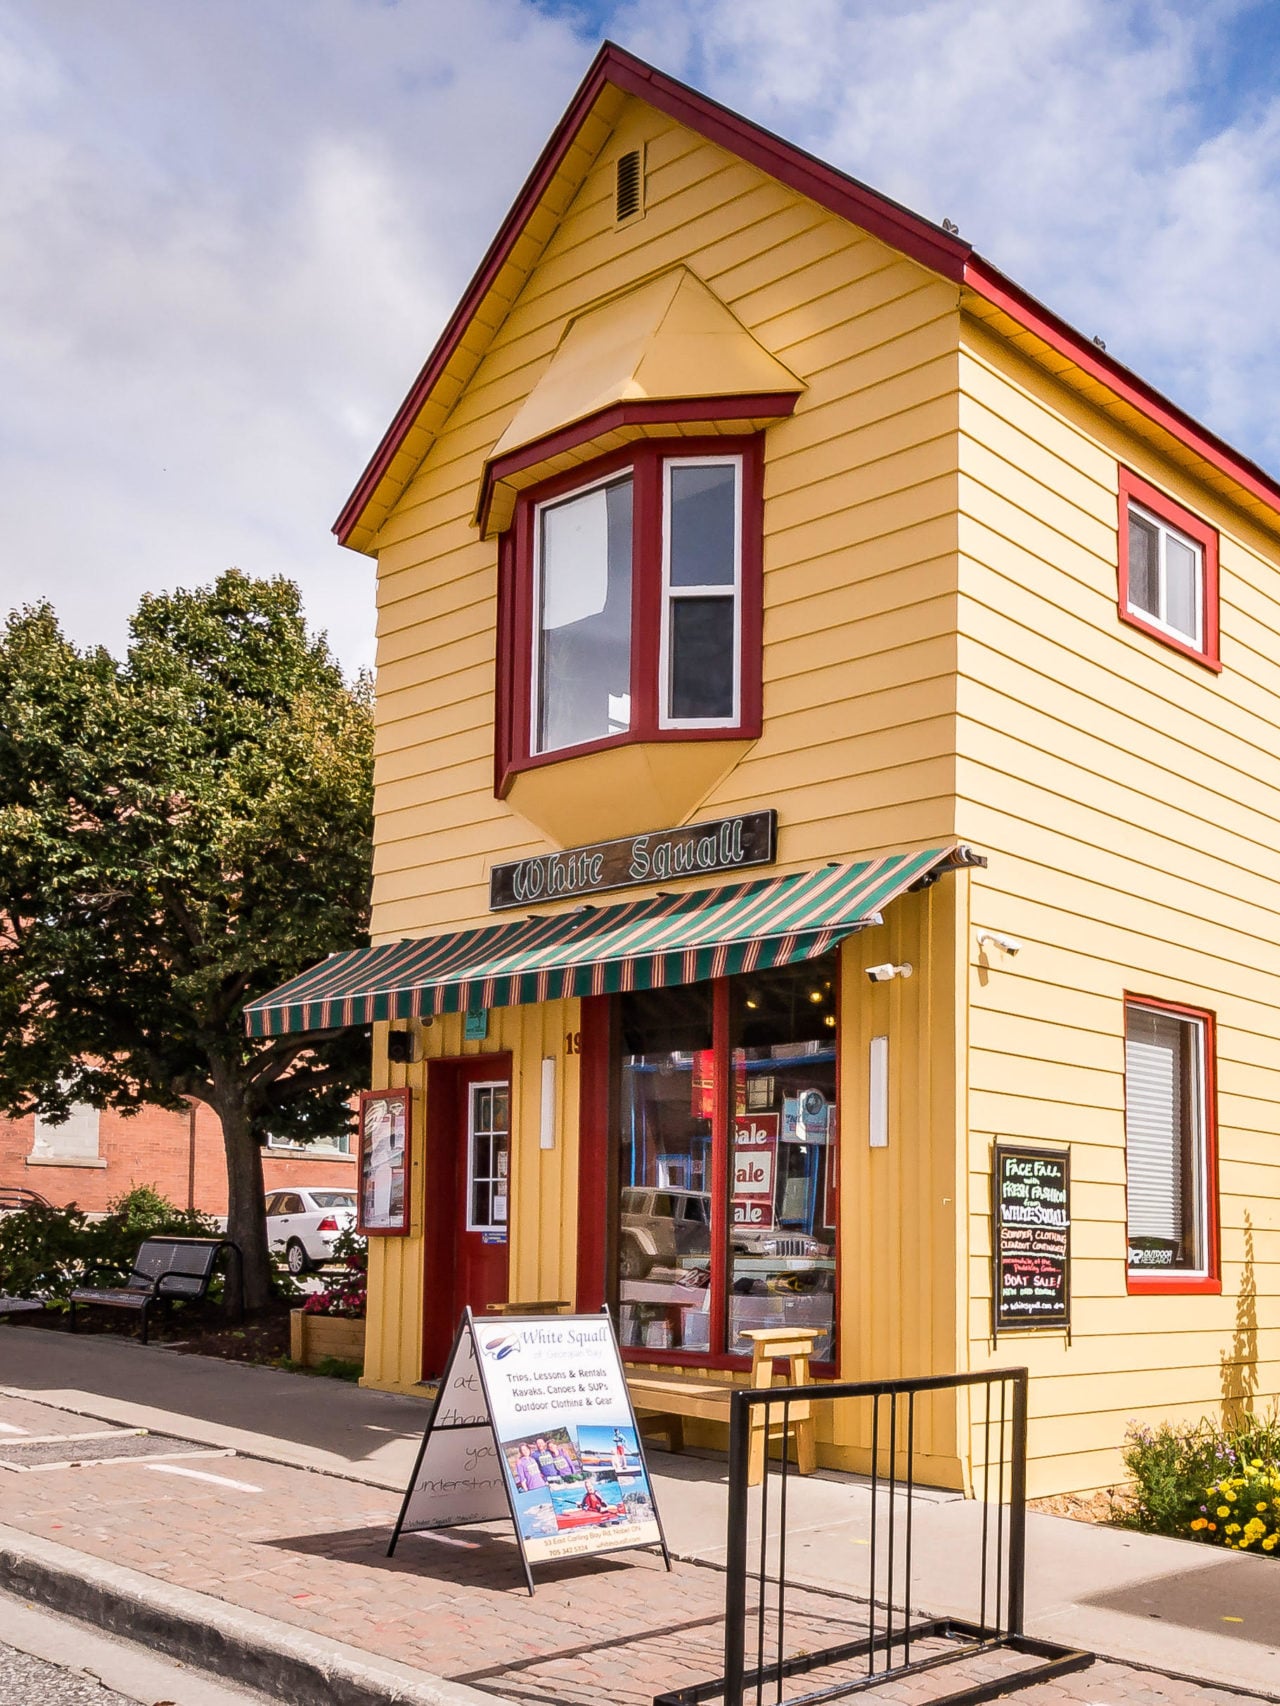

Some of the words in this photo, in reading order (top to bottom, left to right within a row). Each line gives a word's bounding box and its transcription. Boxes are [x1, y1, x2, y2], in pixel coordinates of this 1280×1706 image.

[513, 853, 603, 900] White
[629, 819, 744, 881] Squall
[736, 1161, 764, 1183] ale
[1006, 1158, 1033, 1177] FACE
[1034, 1161, 1061, 1177] FALL
[1003, 1181, 1030, 1198] FRESH
[1031, 1186, 1067, 1203] FASHION
[734, 1201, 762, 1223] ale
[1004, 1274, 1029, 1286] BOAT
[1033, 1274, 1062, 1288] SALE!
[522, 1328, 563, 1344] White
[567, 1327, 608, 1347] Squall
[453, 1374, 480, 1392] at
[533, 1372, 566, 1381] Lessons
[569, 1370, 576, 1378] &
[579, 1368, 607, 1378] Rentals
[547, 1385, 576, 1395] Canoes
[578, 1383, 585, 1392] &
[588, 1382, 608, 1391] SUPs
[514, 1402, 549, 1412] Outdoor
[551, 1399, 583, 1409] Clothing
[585, 1397, 593, 1406] &
[595, 1397, 612, 1406] Gear
[440, 1408, 489, 1425] than
[413, 1476, 505, 1493] understan
